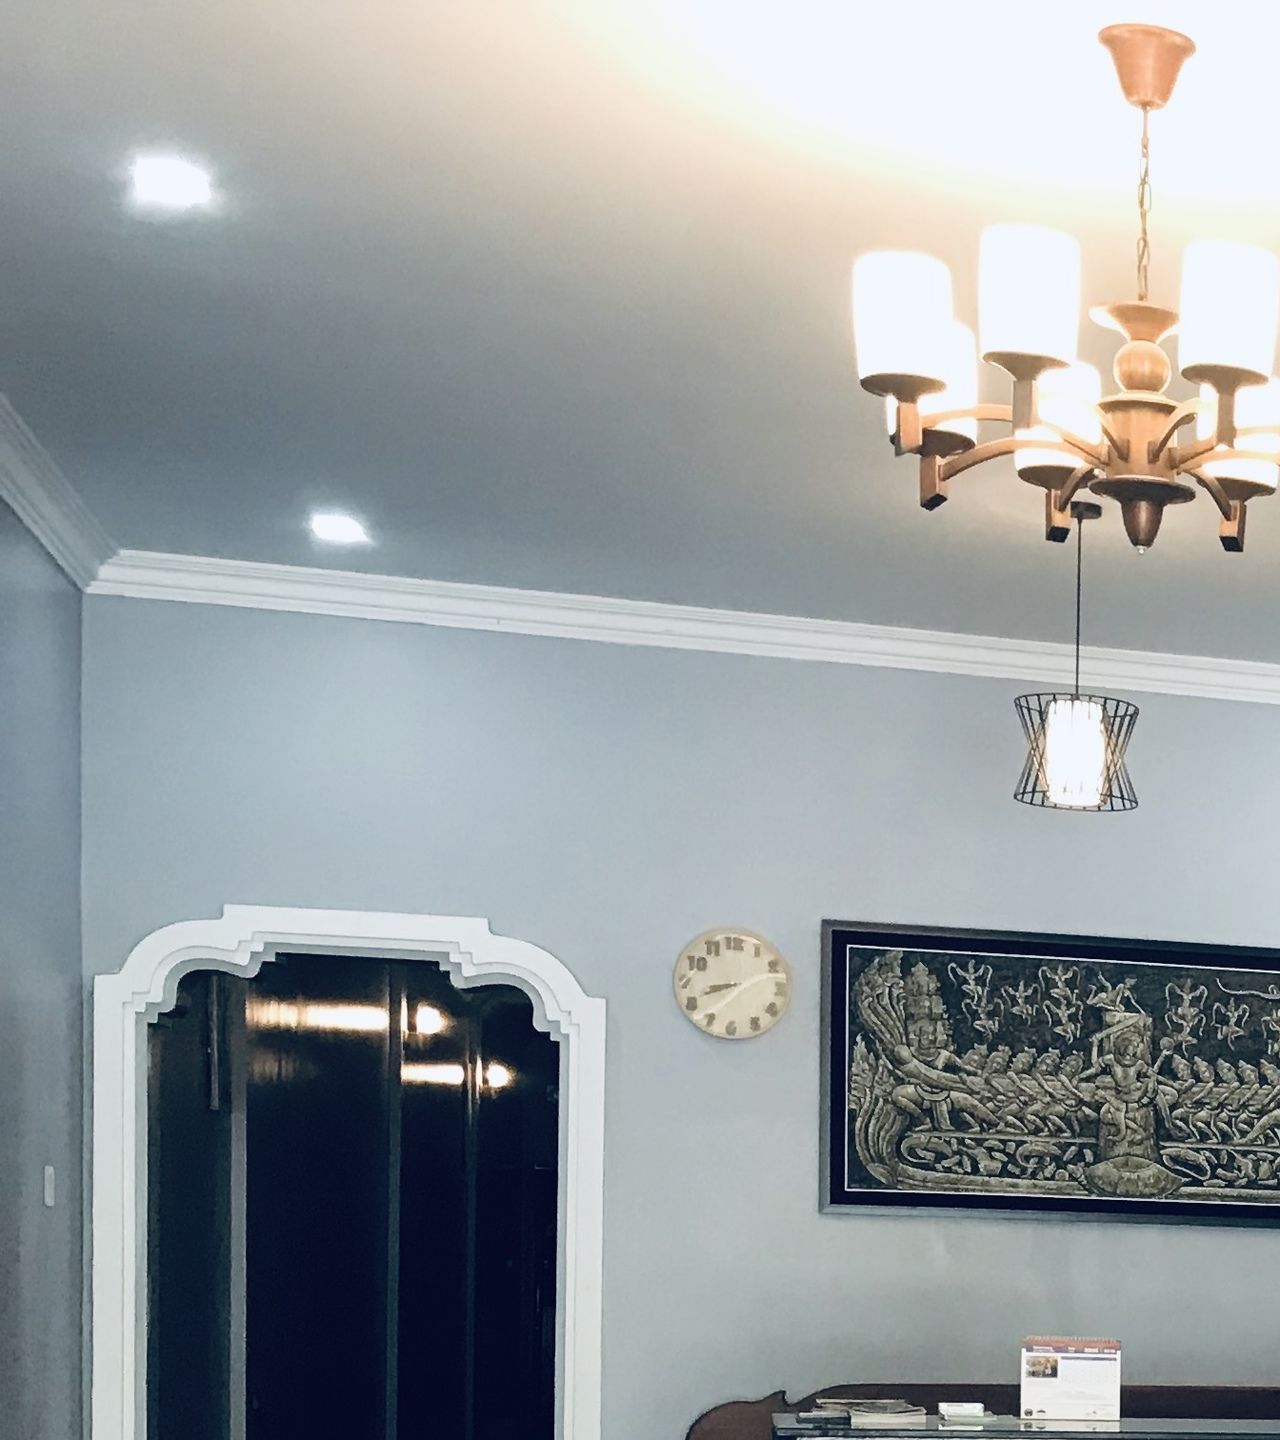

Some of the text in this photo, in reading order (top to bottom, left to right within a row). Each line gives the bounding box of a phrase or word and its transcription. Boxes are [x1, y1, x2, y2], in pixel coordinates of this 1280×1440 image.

[704, 940, 721, 957] 11
[724, 936, 744, 951] 12
[753, 943, 761, 958] 1
[687, 955, 708, 971] 10
[725, 1020, 737, 1036] 6
